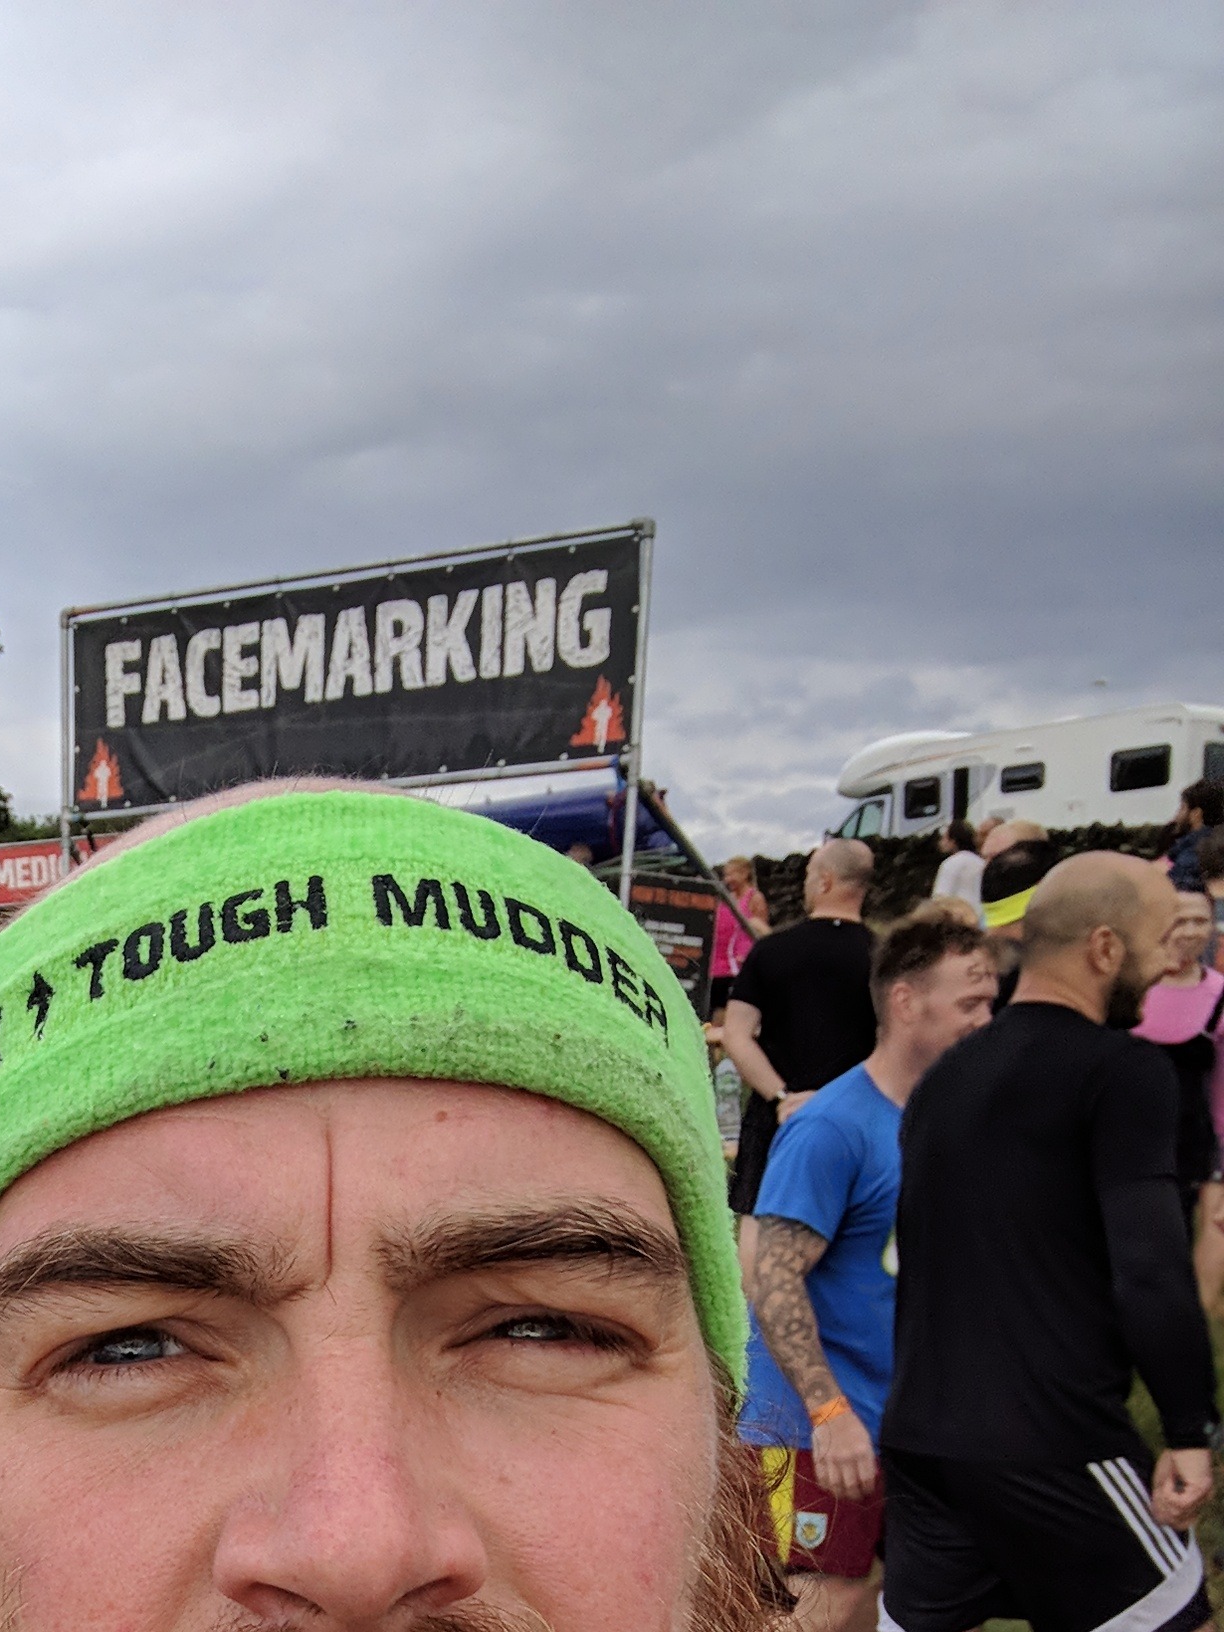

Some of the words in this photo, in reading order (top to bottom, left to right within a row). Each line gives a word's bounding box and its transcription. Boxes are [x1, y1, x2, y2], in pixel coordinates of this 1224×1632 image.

[104, 568, 612, 727] FACEMARKING
[72, 875, 327, 1002] TOUGH
[372, 874, 669, 1049] MUDDER
